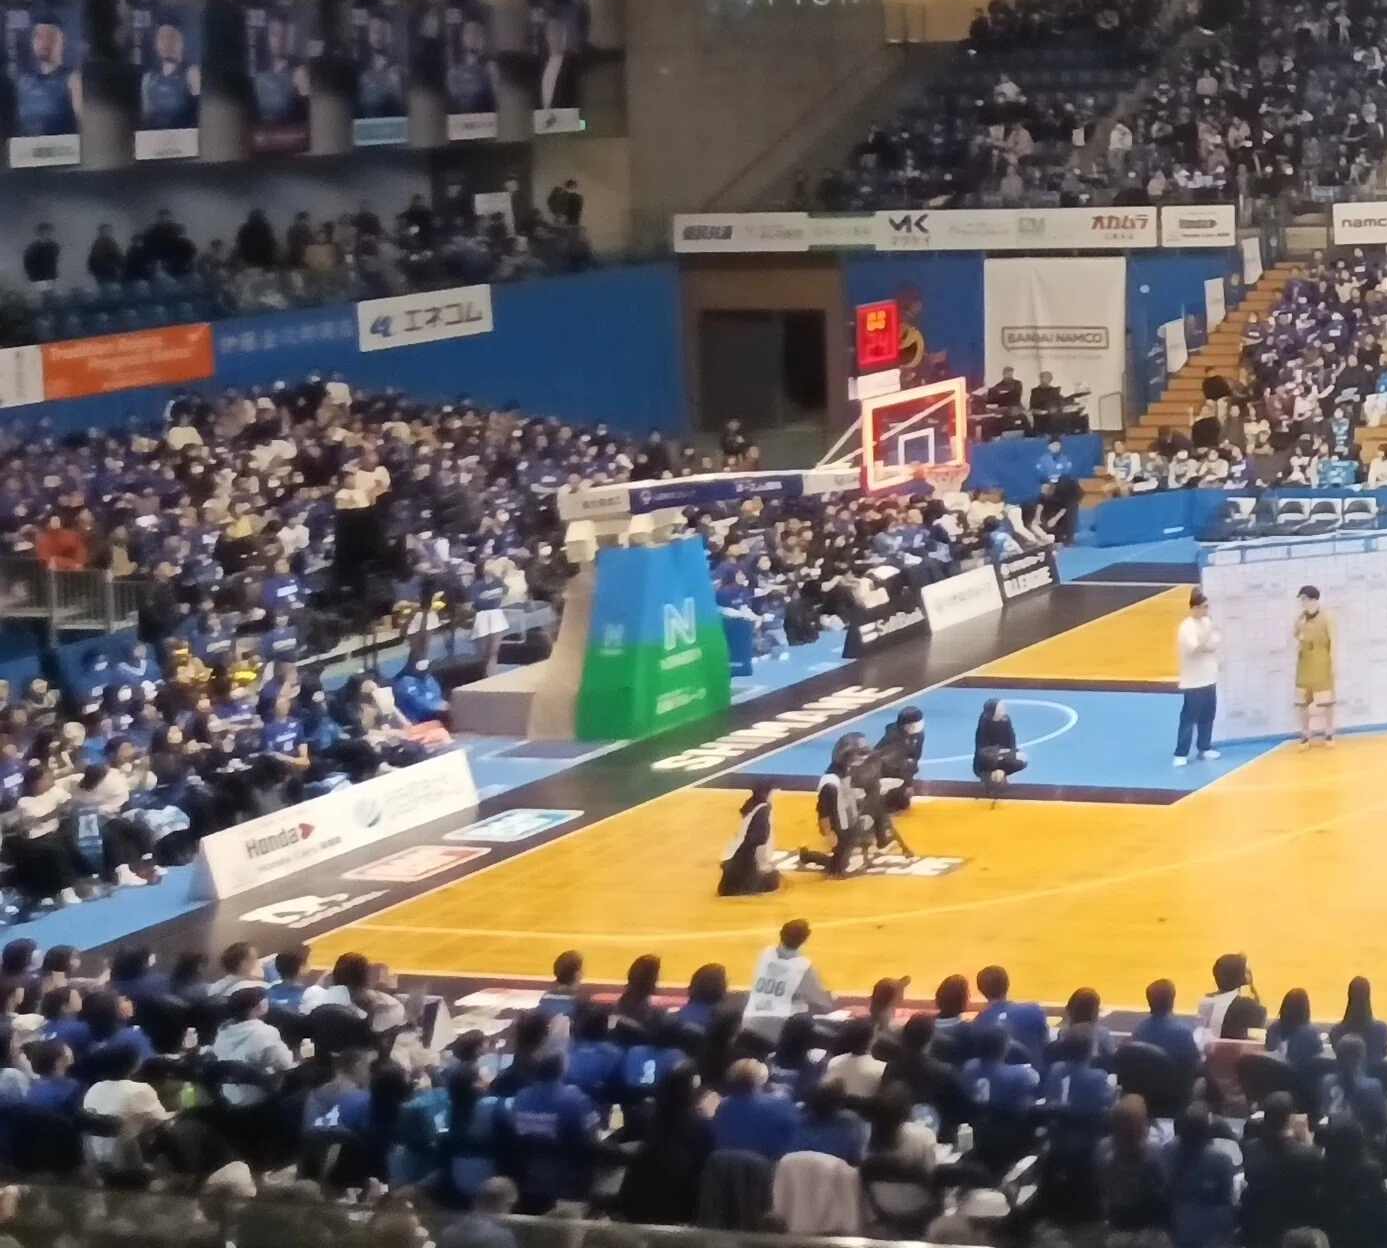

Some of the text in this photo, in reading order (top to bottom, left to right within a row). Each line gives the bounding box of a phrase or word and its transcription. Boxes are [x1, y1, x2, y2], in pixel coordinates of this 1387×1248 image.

[663, 596, 697, 651] N
[650, 684, 905, 772] SHIMANE
[244, 826, 302, 860] Honda
